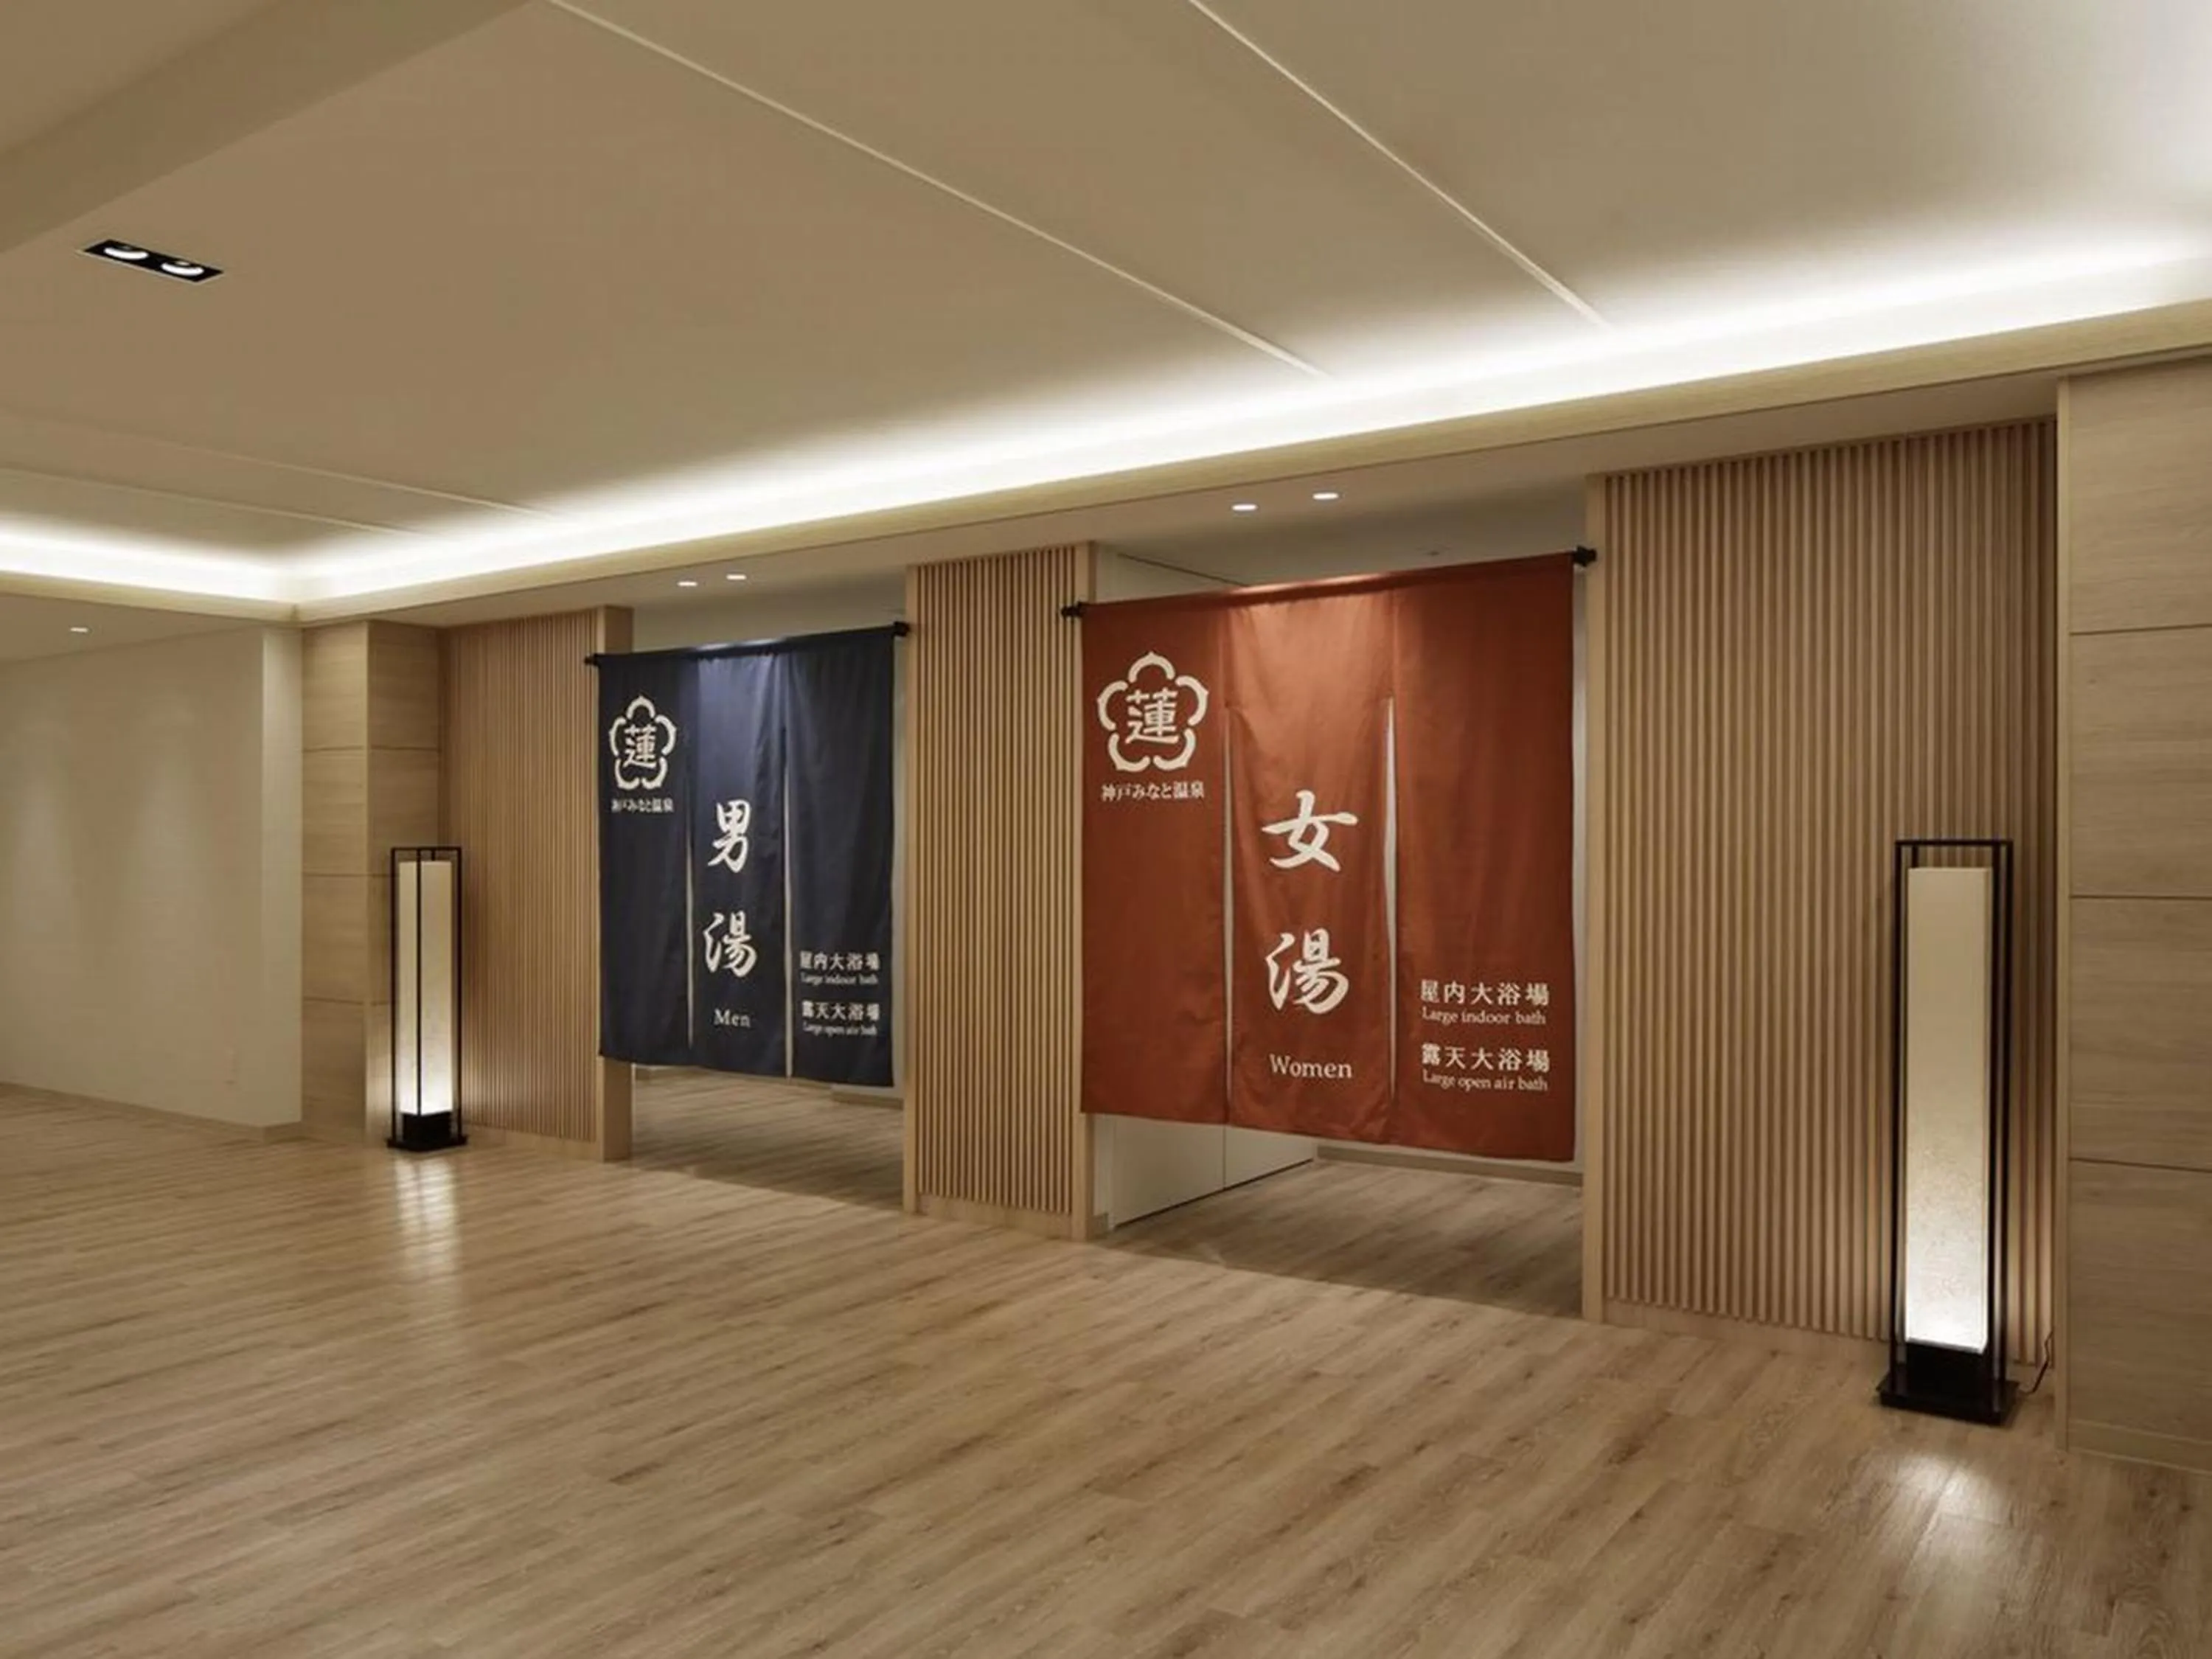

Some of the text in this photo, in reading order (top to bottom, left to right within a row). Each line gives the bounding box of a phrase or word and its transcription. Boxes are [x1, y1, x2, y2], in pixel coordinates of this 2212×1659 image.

[1125, 684, 1179, 744] 蓮
[624, 724, 657, 768] 蓮
[1102, 780, 1205, 801] 神戸みなと温泉
[703, 799, 757, 978] 男湯
[1262, 789, 1359, 1015] 女湯
[1421, 979, 1549, 1006] 屋内大浴場
[713, 1008, 751, 1028] Men
[1422, 1006, 1546, 1026] Large indoor bath
[1269, 1053, 1353, 1079] Women
[1421, 1042, 1550, 1074] 露天大浴場
[1422, 1068, 1548, 1092] Large open air bath
